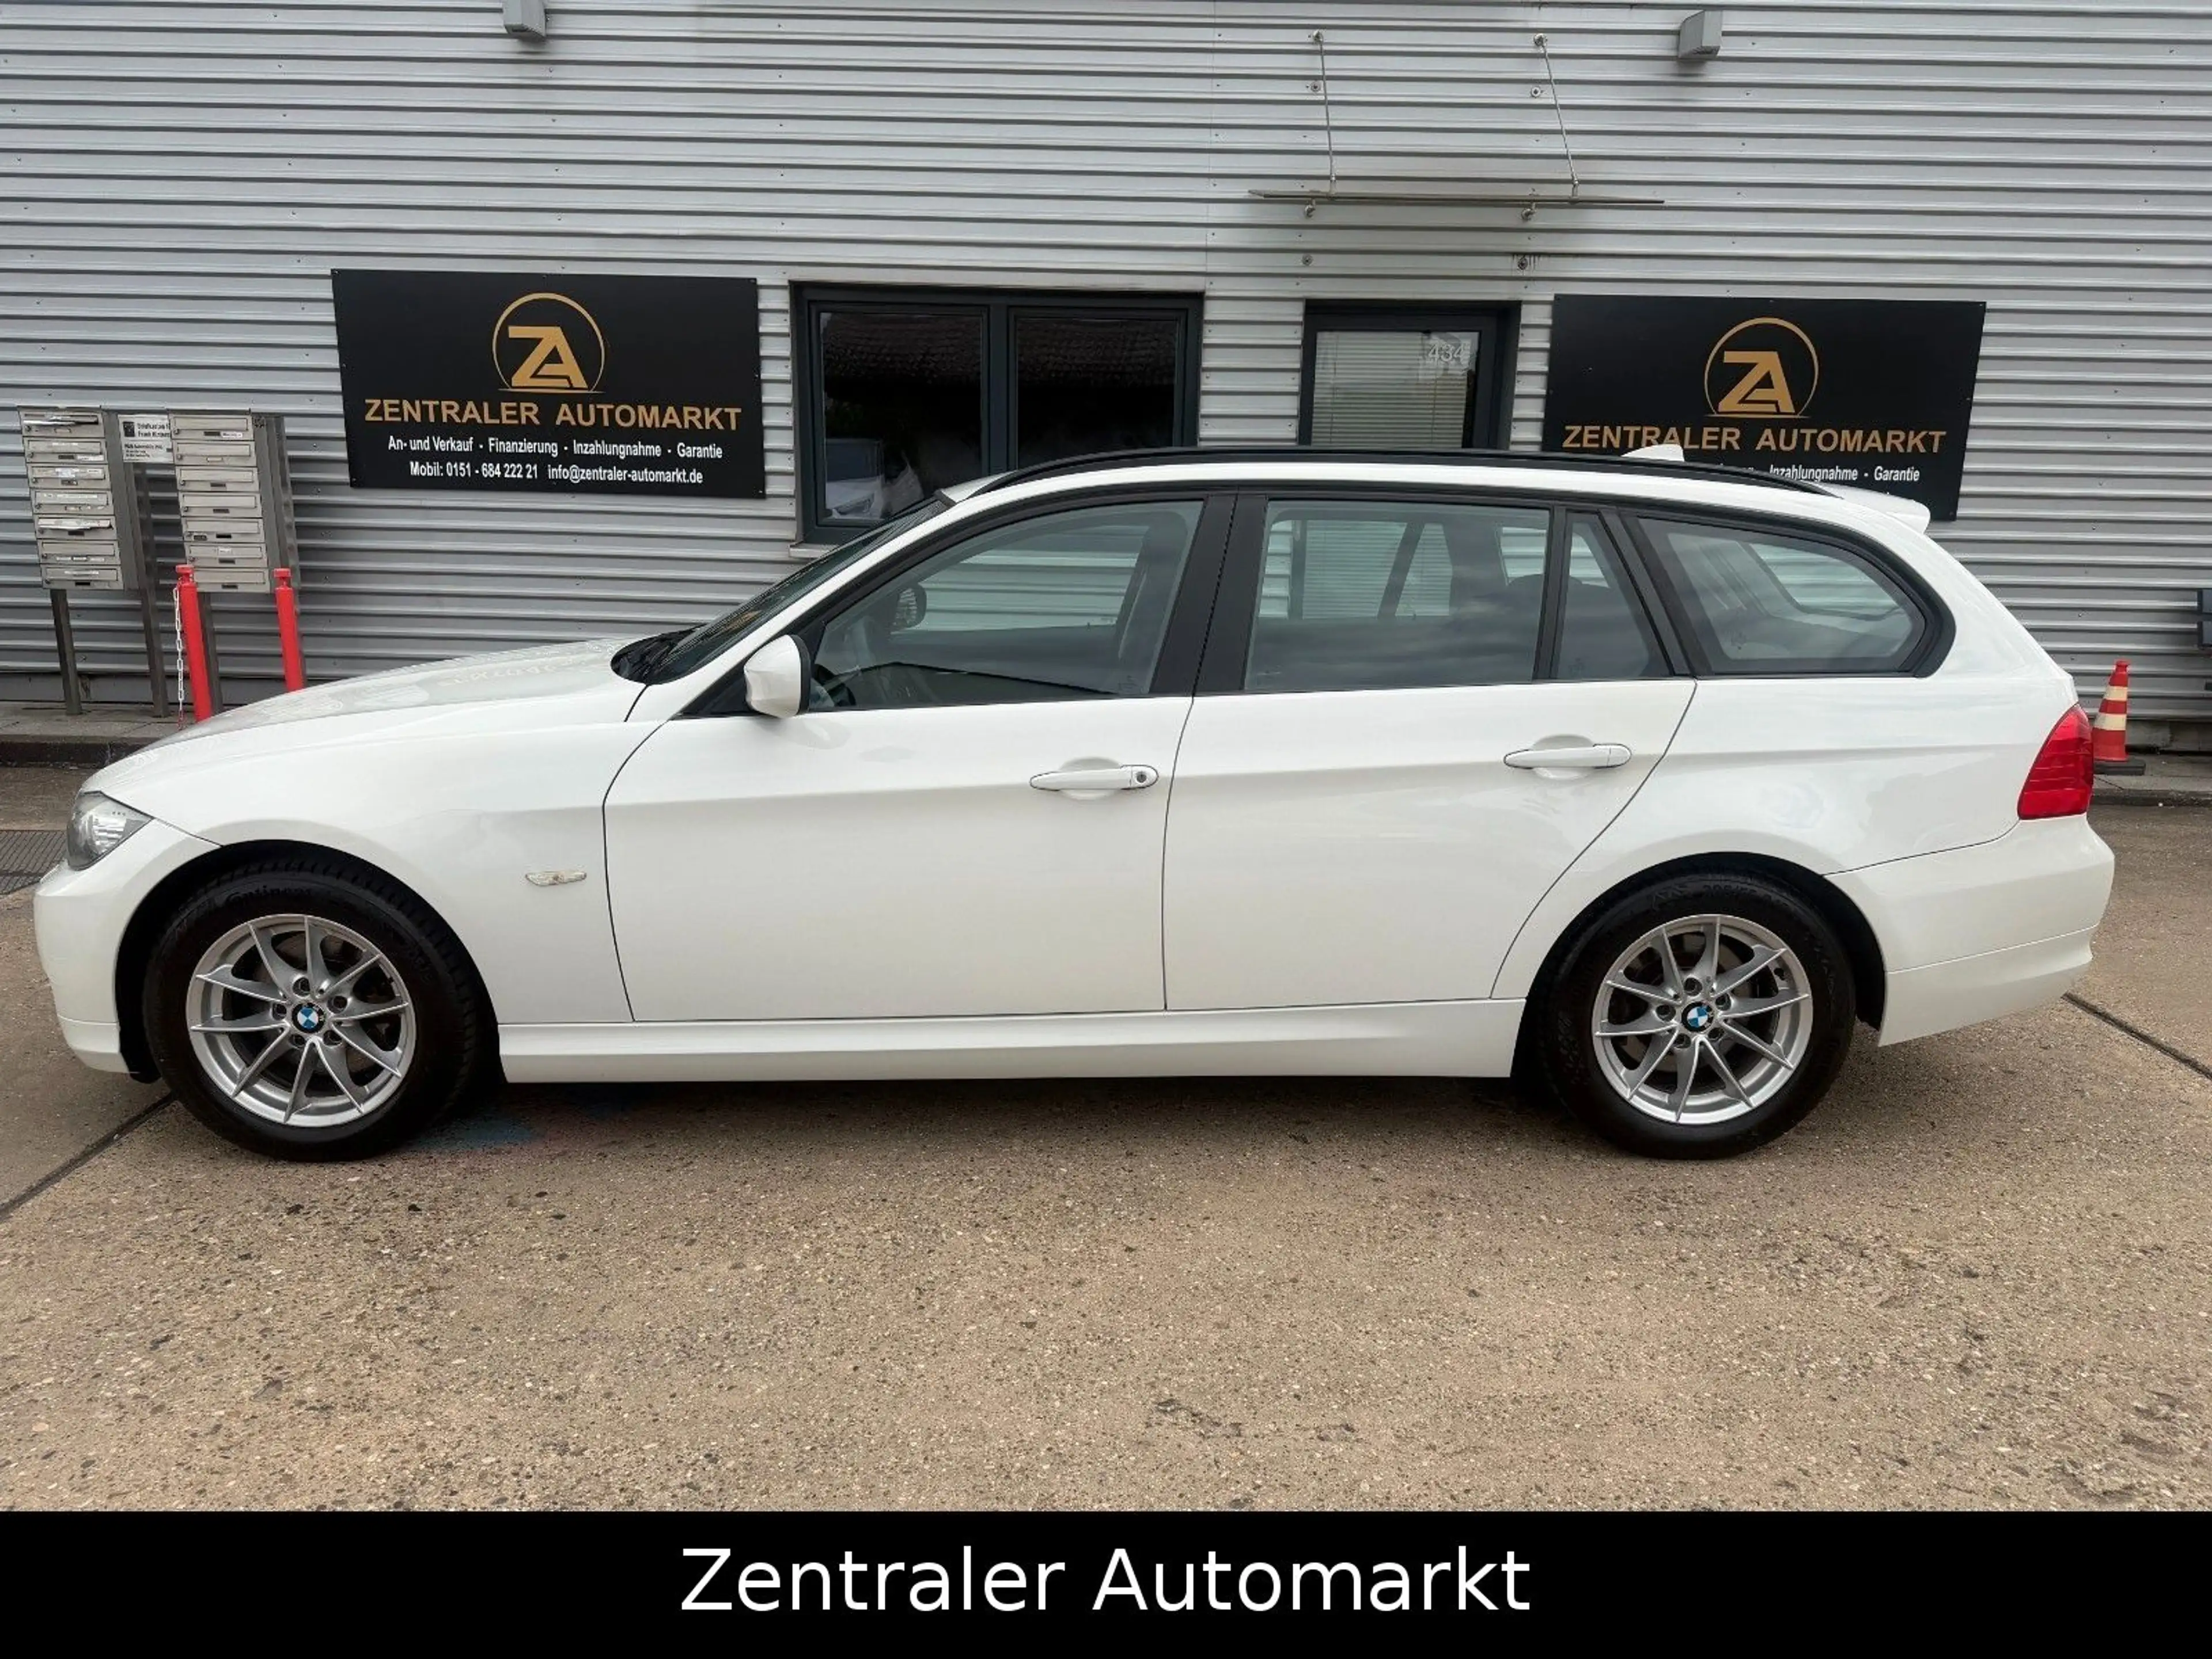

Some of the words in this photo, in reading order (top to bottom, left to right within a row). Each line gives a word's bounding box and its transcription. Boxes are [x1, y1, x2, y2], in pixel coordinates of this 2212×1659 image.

[508, 325, 588, 388] ZA
[1718, 350, 1796, 413] ZA
[365, 399, 540, 425] ZENTRALER
[555, 403, 741, 431] AUTOMARKT
[388, 435, 407, 450] An-
[409, 435, 430, 451] und
[432, 435, 474, 452] Verkauf
[488, 437, 558, 457] Finanzierung
[573, 440, 662, 460] Inzahlungnahme
[677, 442, 723, 459] Garantie
[1562, 425, 1740, 450] ZENTRALER
[1755, 428, 1946, 453] AUTOMARKT
[409, 461, 444, 477] Mobil:
[446, 461, 471, 478] 0151
[481, 462, 501, 478] 684
[503, 463, 524, 479] 222
[525, 464, 538, 479] 21
[547, 464, 703, 483] info@zentraler-automarkt.de
[1874, 465, 1920, 482] Garantie
